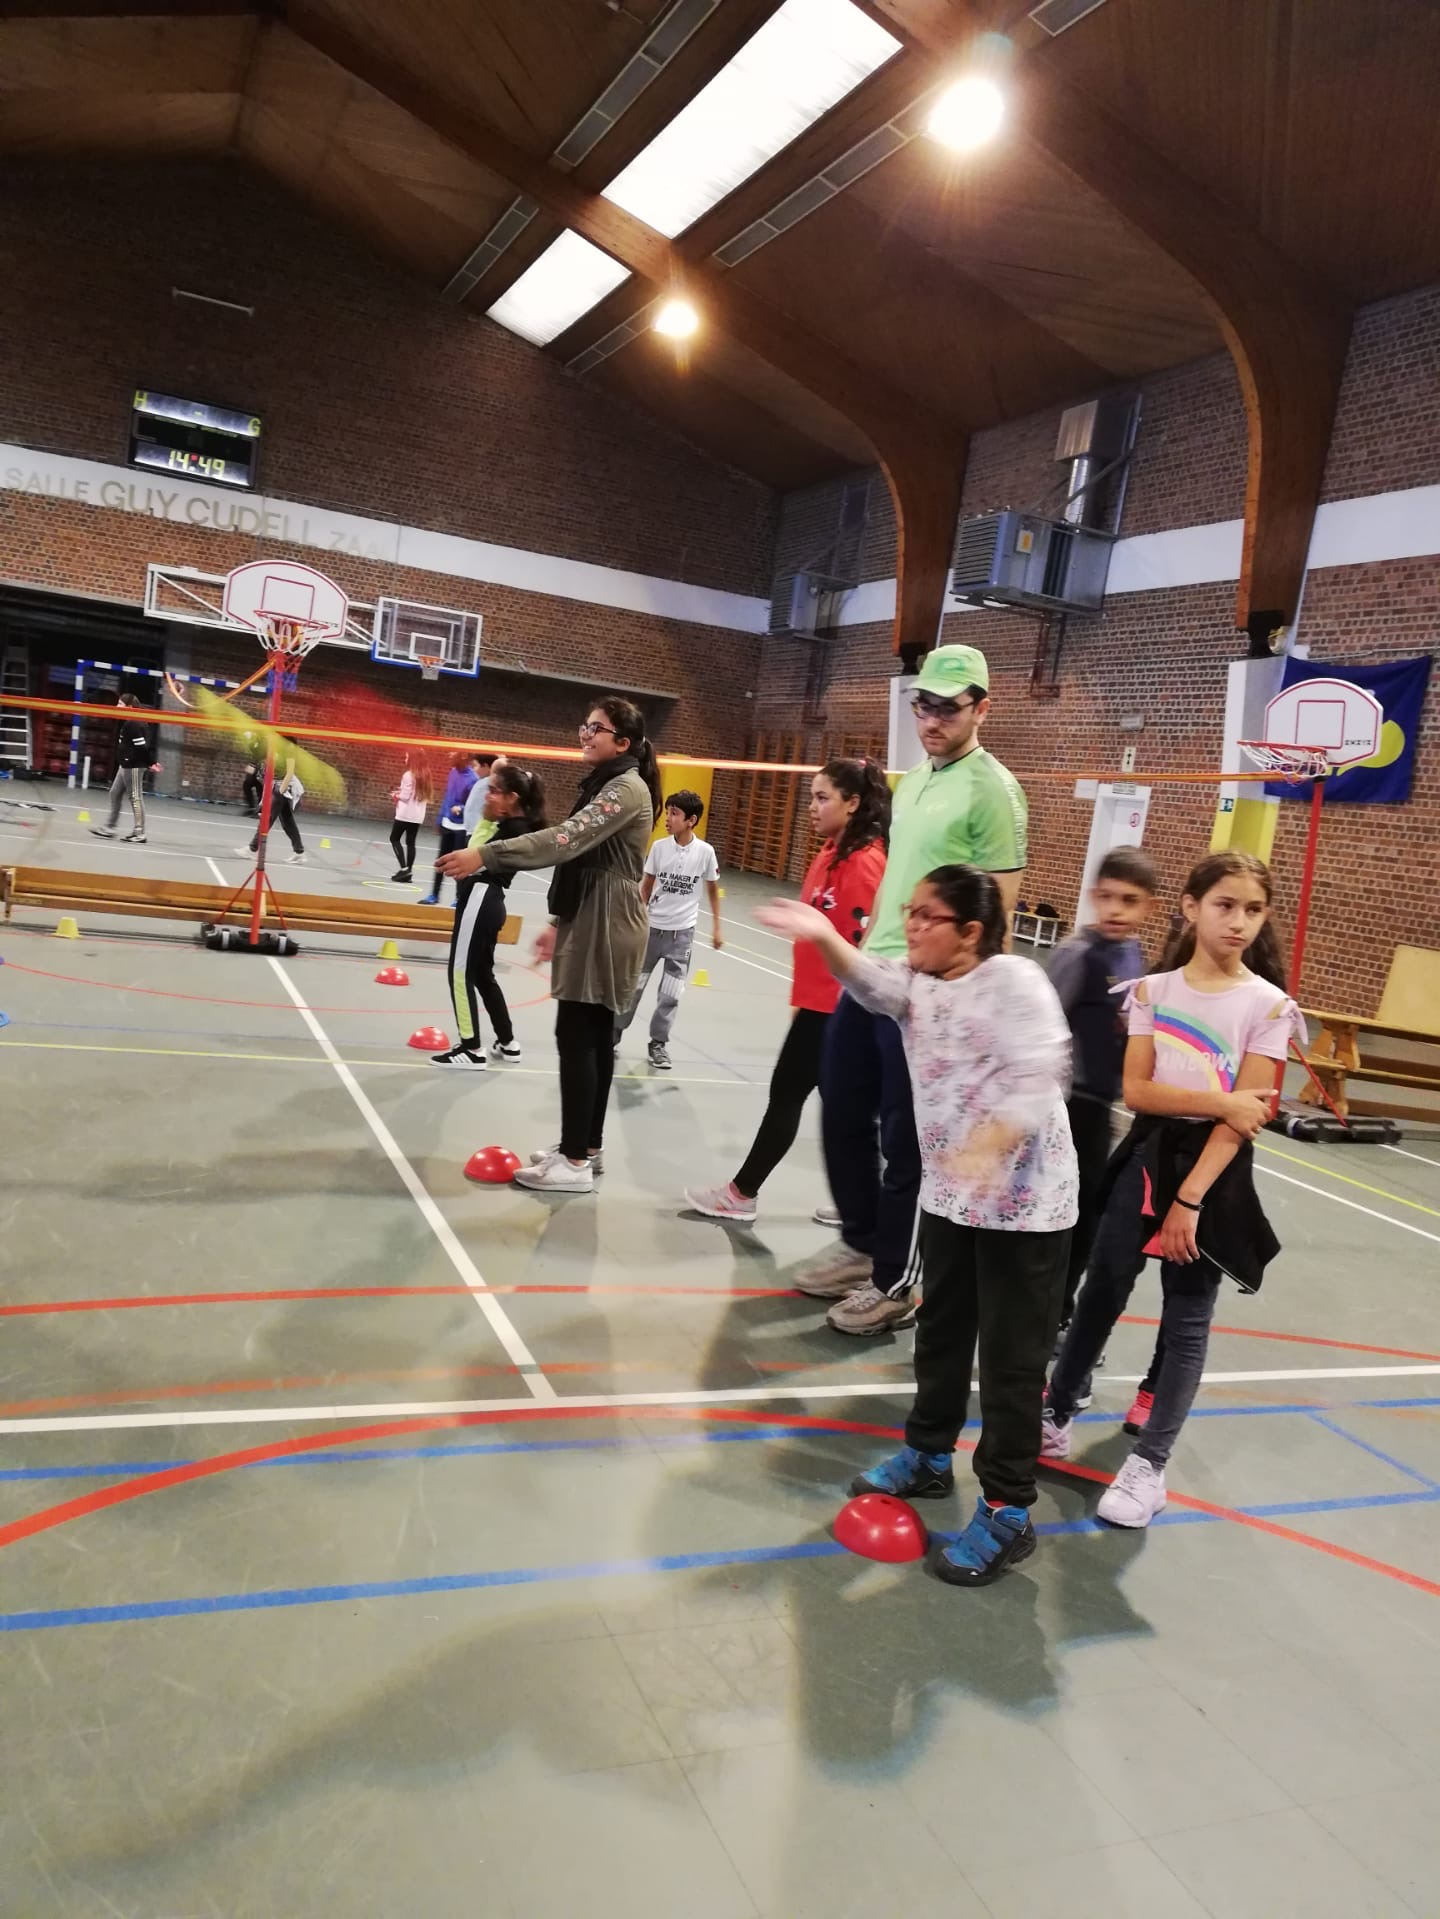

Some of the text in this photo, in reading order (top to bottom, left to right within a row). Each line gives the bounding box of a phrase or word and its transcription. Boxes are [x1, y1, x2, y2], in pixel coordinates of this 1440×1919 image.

[133, 390, 148, 409] H
[247, 417, 262, 437] G
[168, 449, 225, 478] 14:49
[5, 467, 89, 503] SALLE
[99, 480, 180, 519] GUY
[185, 497, 318, 548] CUDELL
